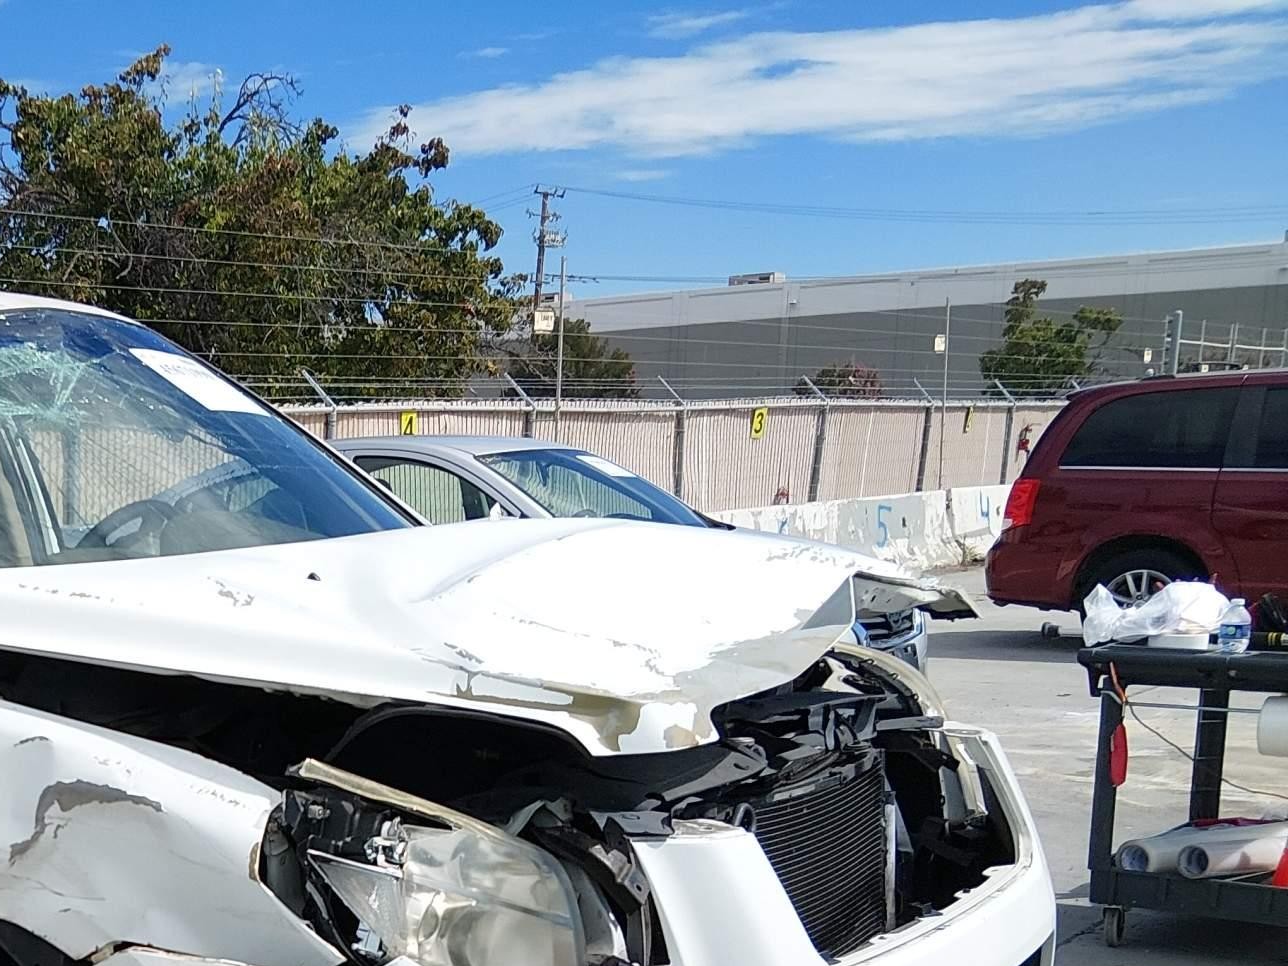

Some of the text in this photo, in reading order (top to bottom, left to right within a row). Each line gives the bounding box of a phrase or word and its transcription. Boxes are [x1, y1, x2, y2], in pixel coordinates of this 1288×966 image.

[403, 415, 415, 436] 4
[754, 412, 764, 434] 3
[876, 504, 892, 548] 5
